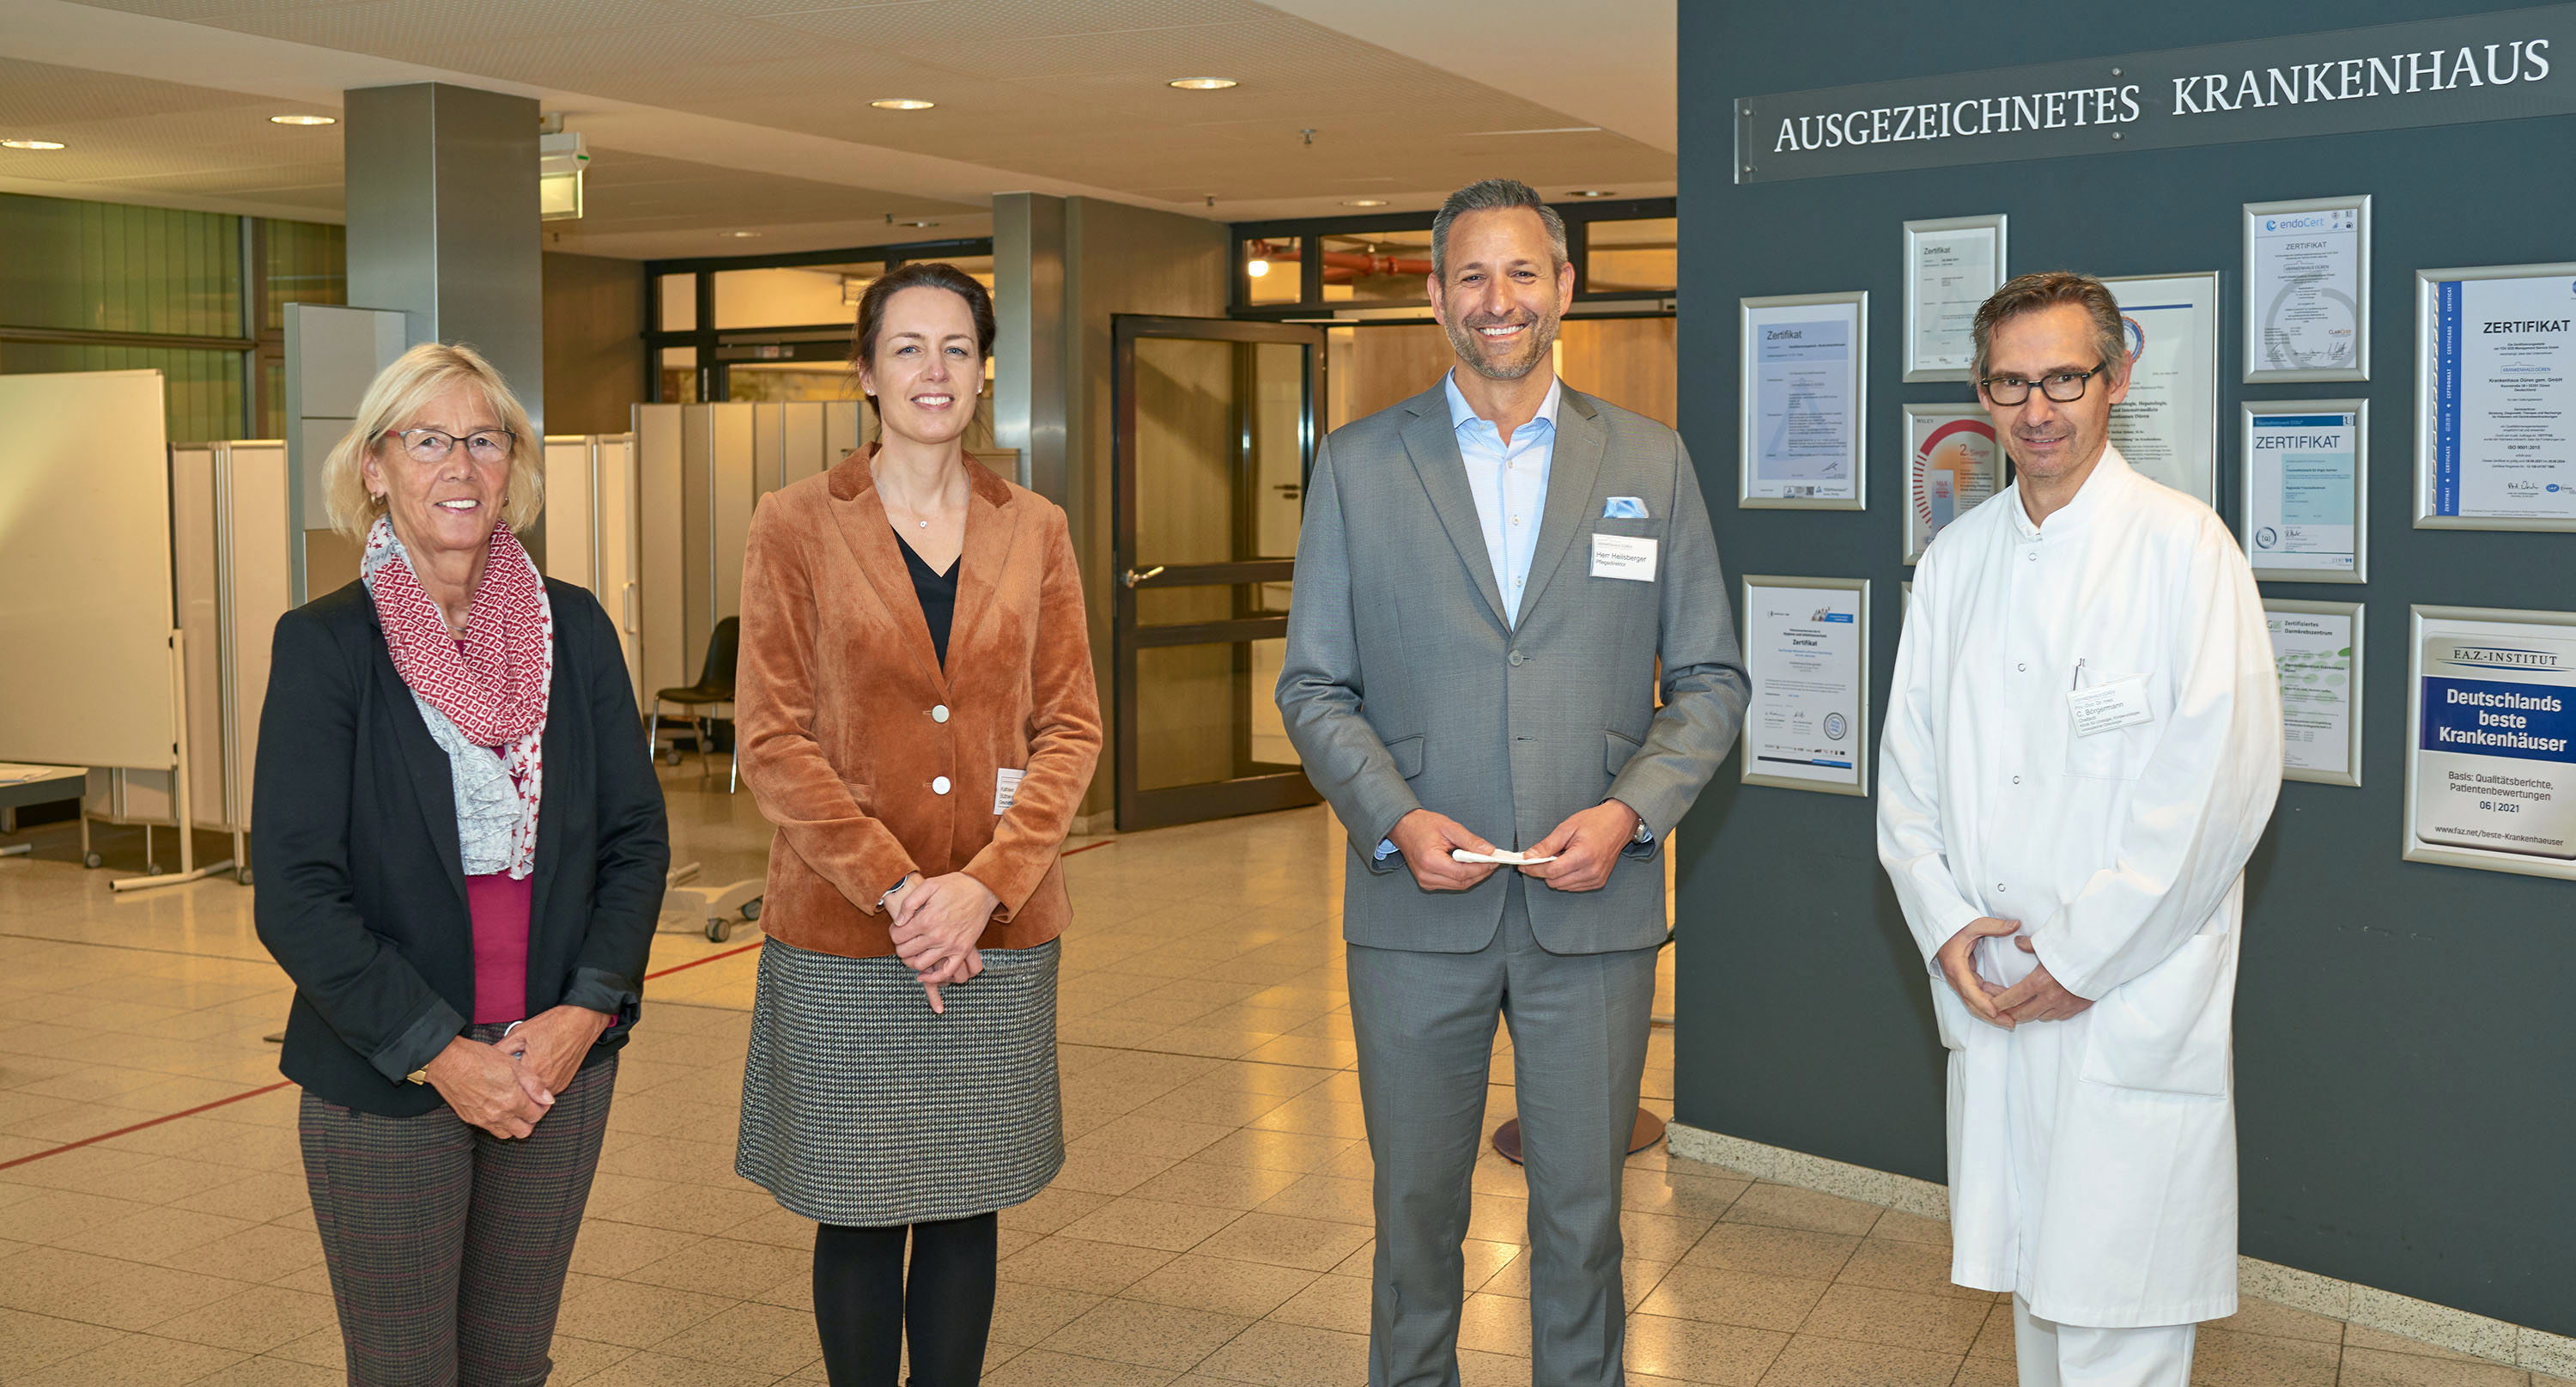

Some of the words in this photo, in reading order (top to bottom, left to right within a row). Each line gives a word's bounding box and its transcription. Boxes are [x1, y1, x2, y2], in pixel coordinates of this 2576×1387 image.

[1774, 84, 2141, 153] AUSGEZEICHNETES
[2172, 39, 2549, 116] KRANKENHAUS
[2280, 216, 2325, 229] endoCert
[2285, 241, 2327, 250] ZERTIFIKAT
[2482, 319, 2571, 334] ZERTIFIKAT
[1766, 330, 1802, 341] Zertifikat
[2256, 435, 2341, 448] ZERTIFIKAT
[1611, 552, 1647, 563] Heilsberger
[2453, 649, 2558, 666] F.A.Z.-INSTITUT
[2446, 688, 2562, 713] Deutschlands
[2478, 709, 2527, 729] beste
[2439, 726, 2567, 752] Krankenhäuser
[2448, 771, 2474, 782] Basis:
[2476, 773, 2554, 791] Qualitätsberichte,
[2450, 782, 2551, 802] Patientenbewertungen
[2479, 800, 2491, 811] 06
[2497, 802, 2519, 813] 2021
[2435, 825, 2564, 847] www.faz.net/beste-Krankenhaeuser
